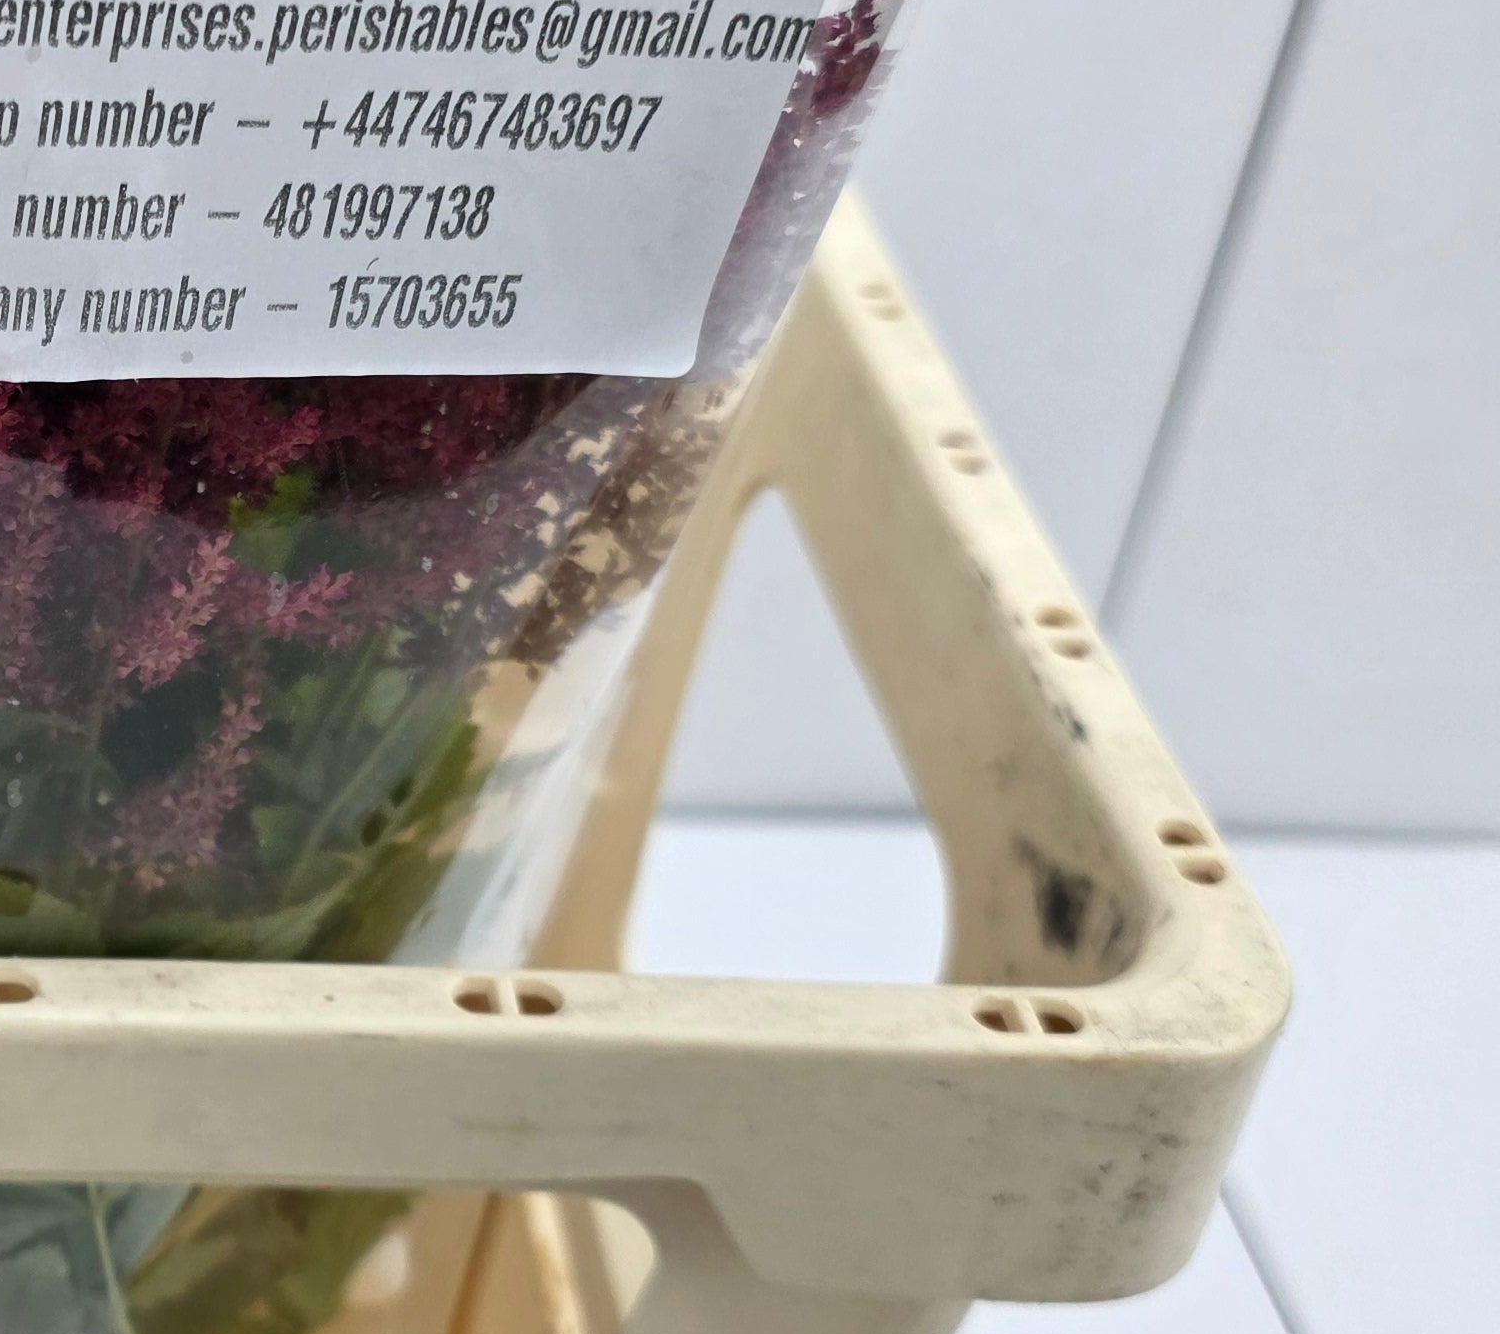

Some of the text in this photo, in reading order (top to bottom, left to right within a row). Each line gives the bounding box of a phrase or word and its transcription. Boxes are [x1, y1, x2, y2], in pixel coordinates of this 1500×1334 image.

[36, 86, 216, 149] number
[302, 90, 664, 154] +447467483697
[12, 183, 187, 242] number
[262, 182, 496, 241] 481997138
[79, 275, 247, 335] number
[328, 274, 524, 331] 15703655
